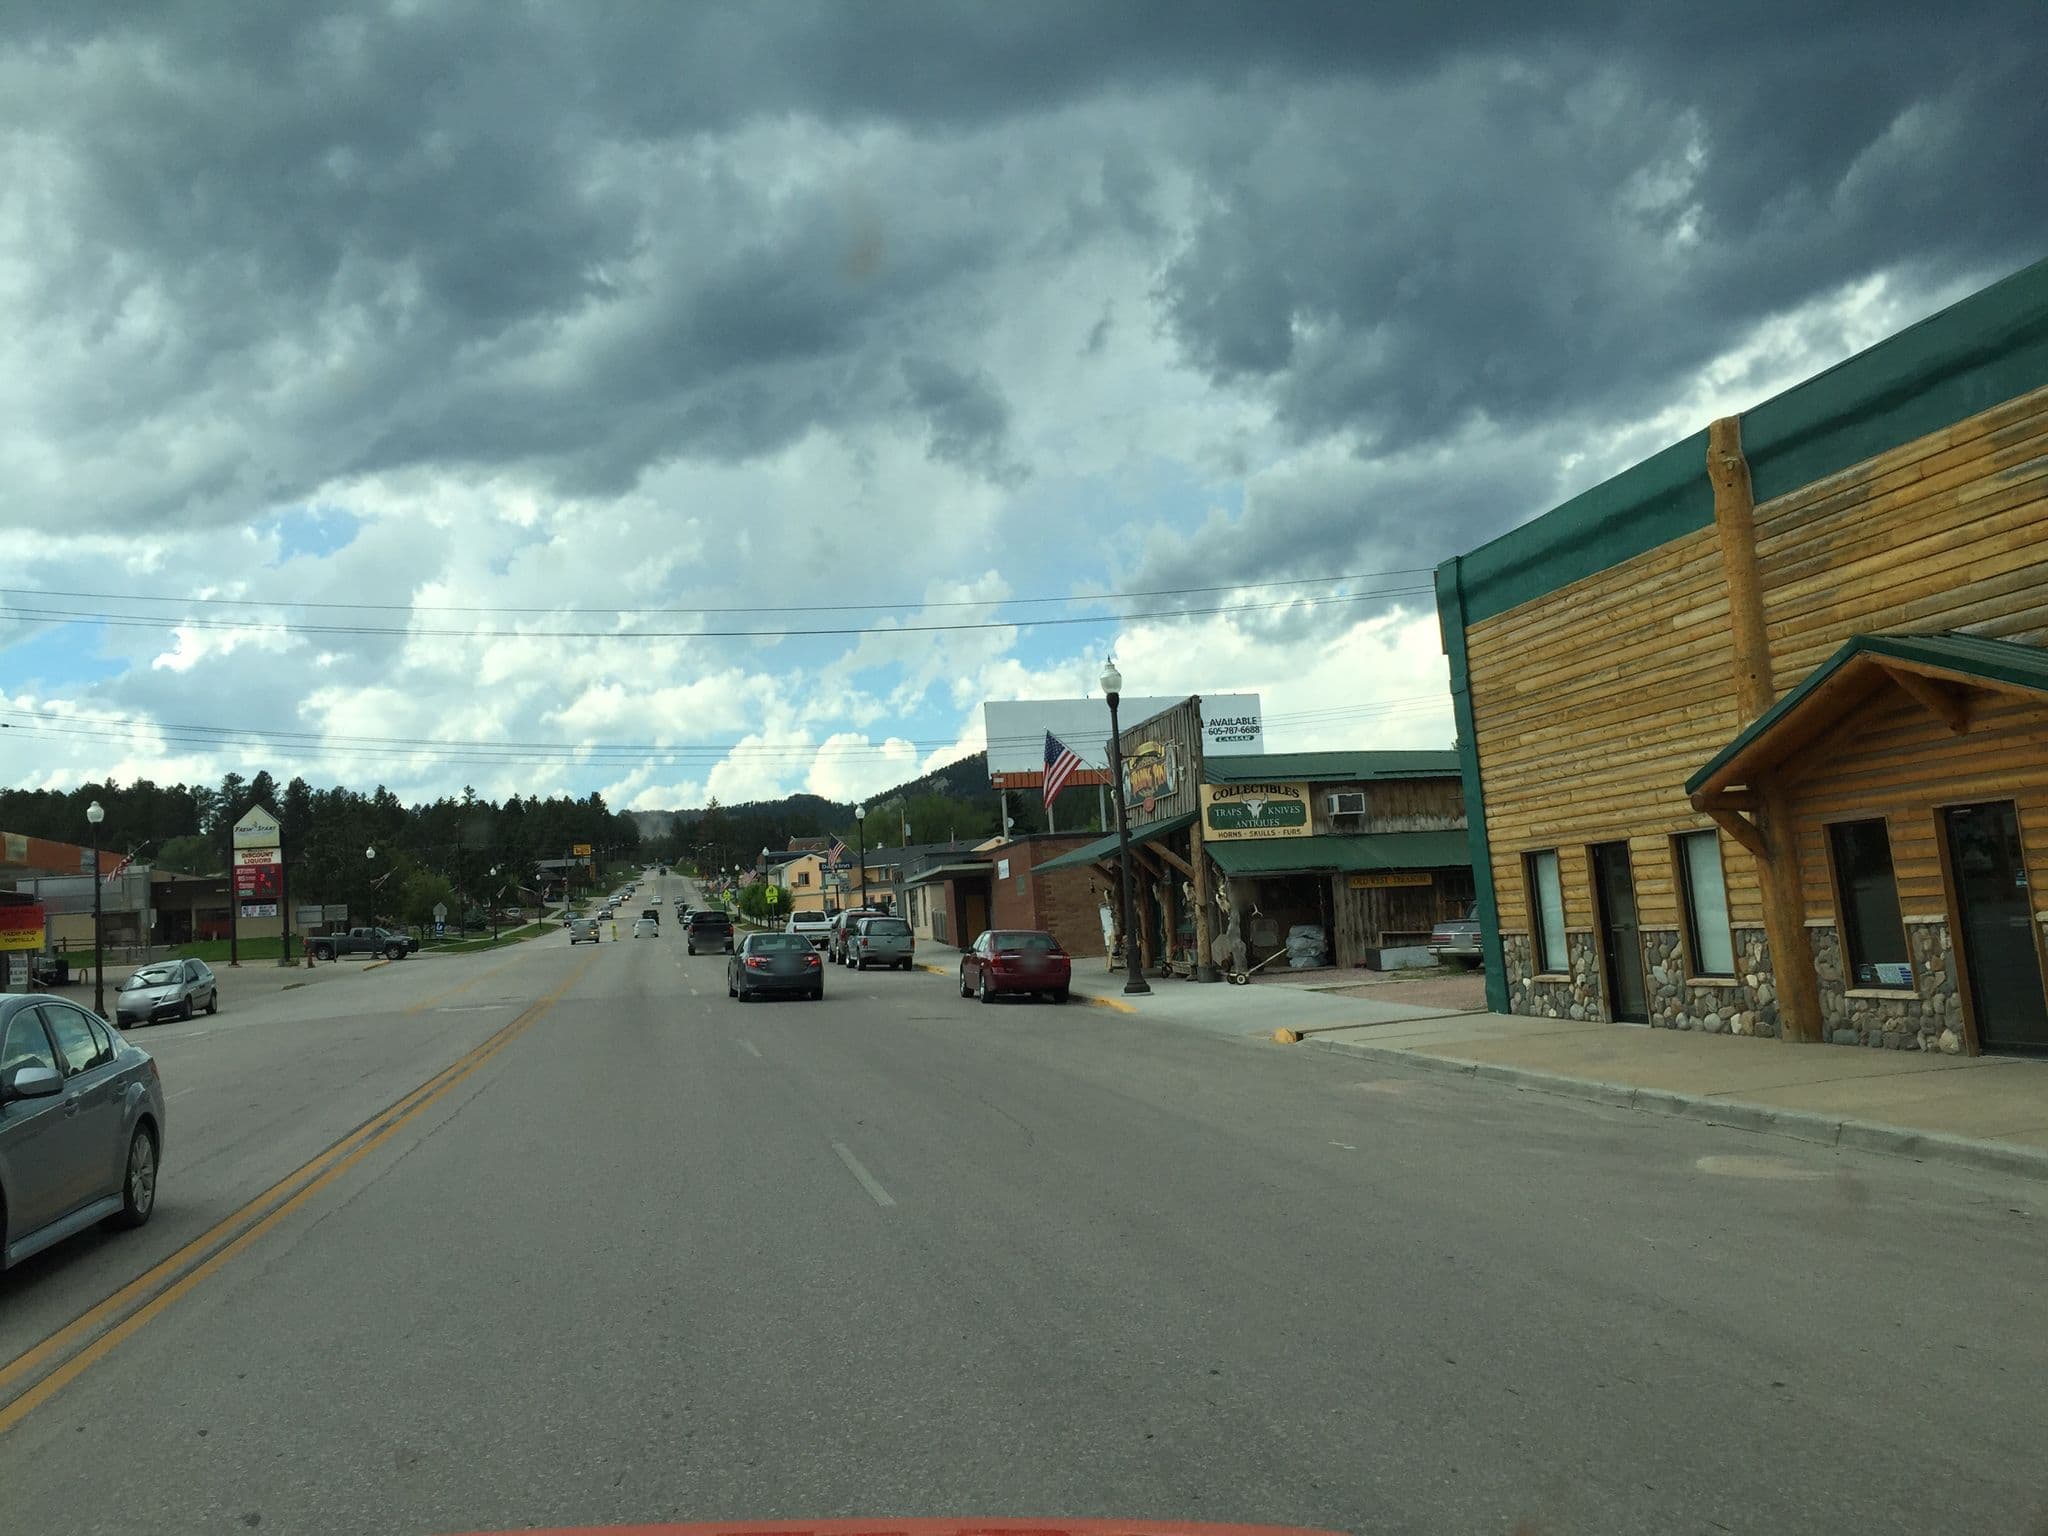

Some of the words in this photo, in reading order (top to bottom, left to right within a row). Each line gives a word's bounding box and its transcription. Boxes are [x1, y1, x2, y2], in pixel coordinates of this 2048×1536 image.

[1210, 717, 1257, 726] AVAILABLE
[1208, 726, 1260, 735] 605-787-6688
[1212, 784, 1300, 800] COLLECTIBLES
[1215, 807, 1242, 817] TRAPS
[1267, 805, 1301, 815] KNIVES
[1236, 818, 1280, 828] ANTIQUES
[1218, 831, 1242, 839] HORNS
[1249, 829, 1276, 837] SKULLS
